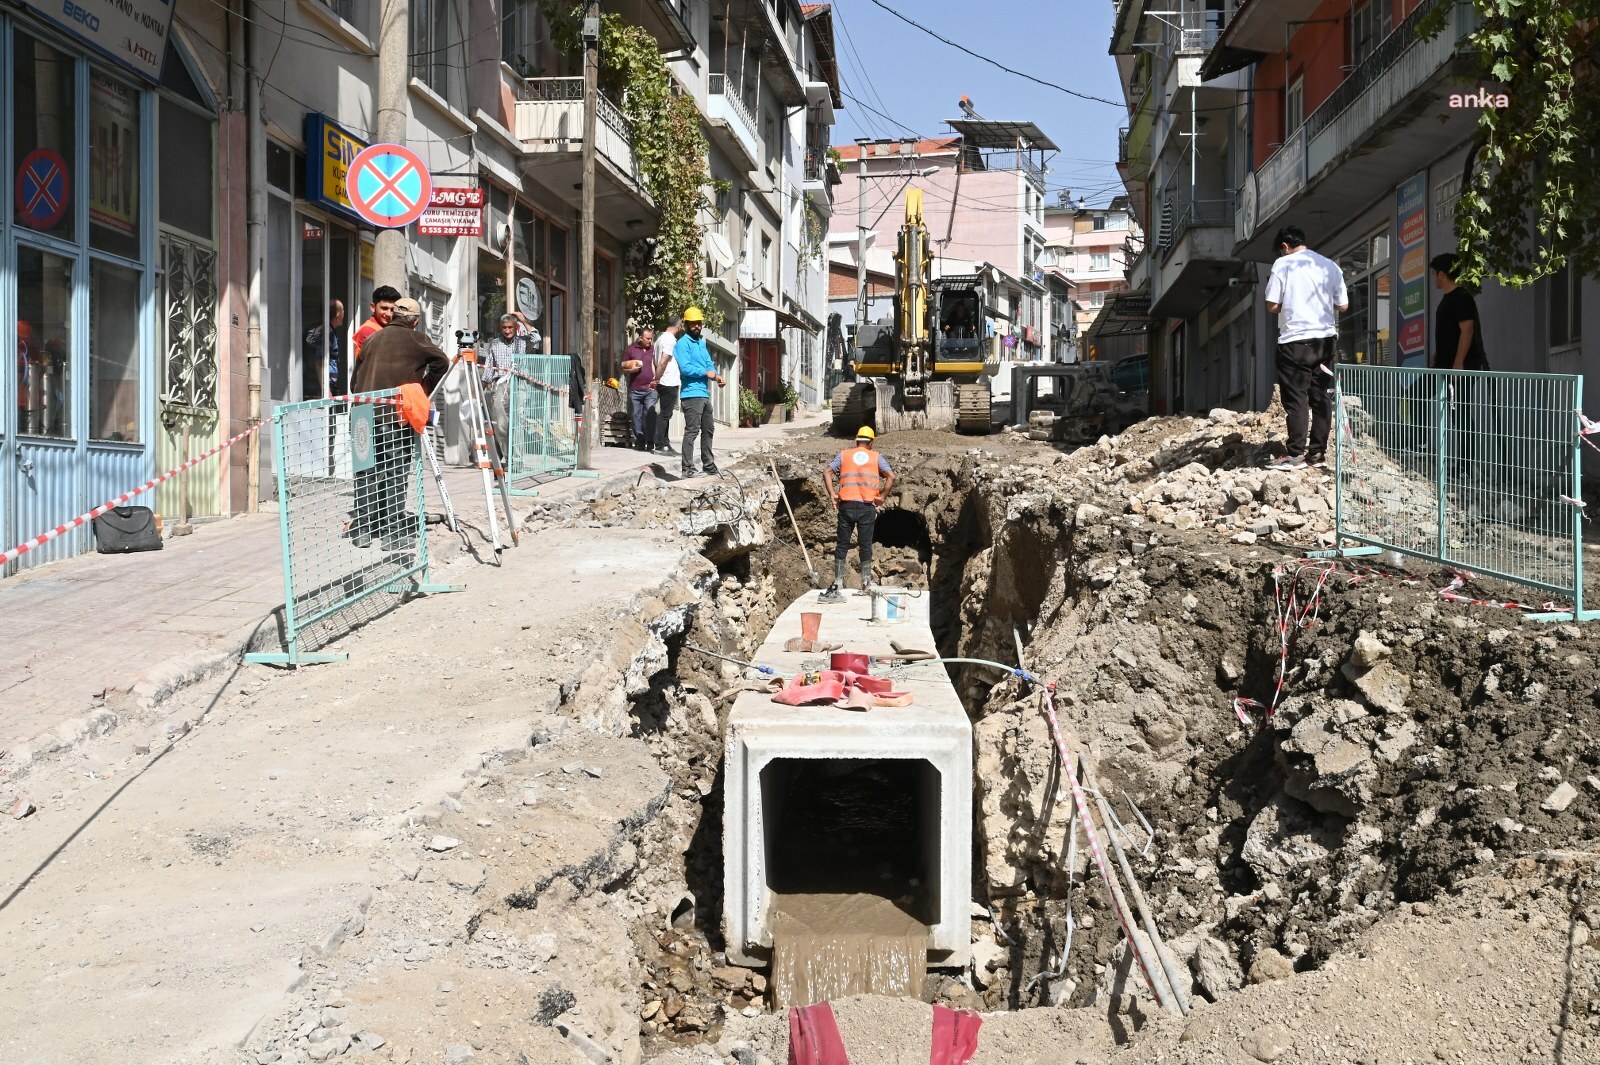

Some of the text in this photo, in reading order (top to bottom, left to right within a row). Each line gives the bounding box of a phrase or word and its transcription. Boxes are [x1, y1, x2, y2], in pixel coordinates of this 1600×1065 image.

[63, 0, 100, 32] BEKO
[332, 165, 347, 182] KUR
[1404, 291, 1420, 306] TABLET
